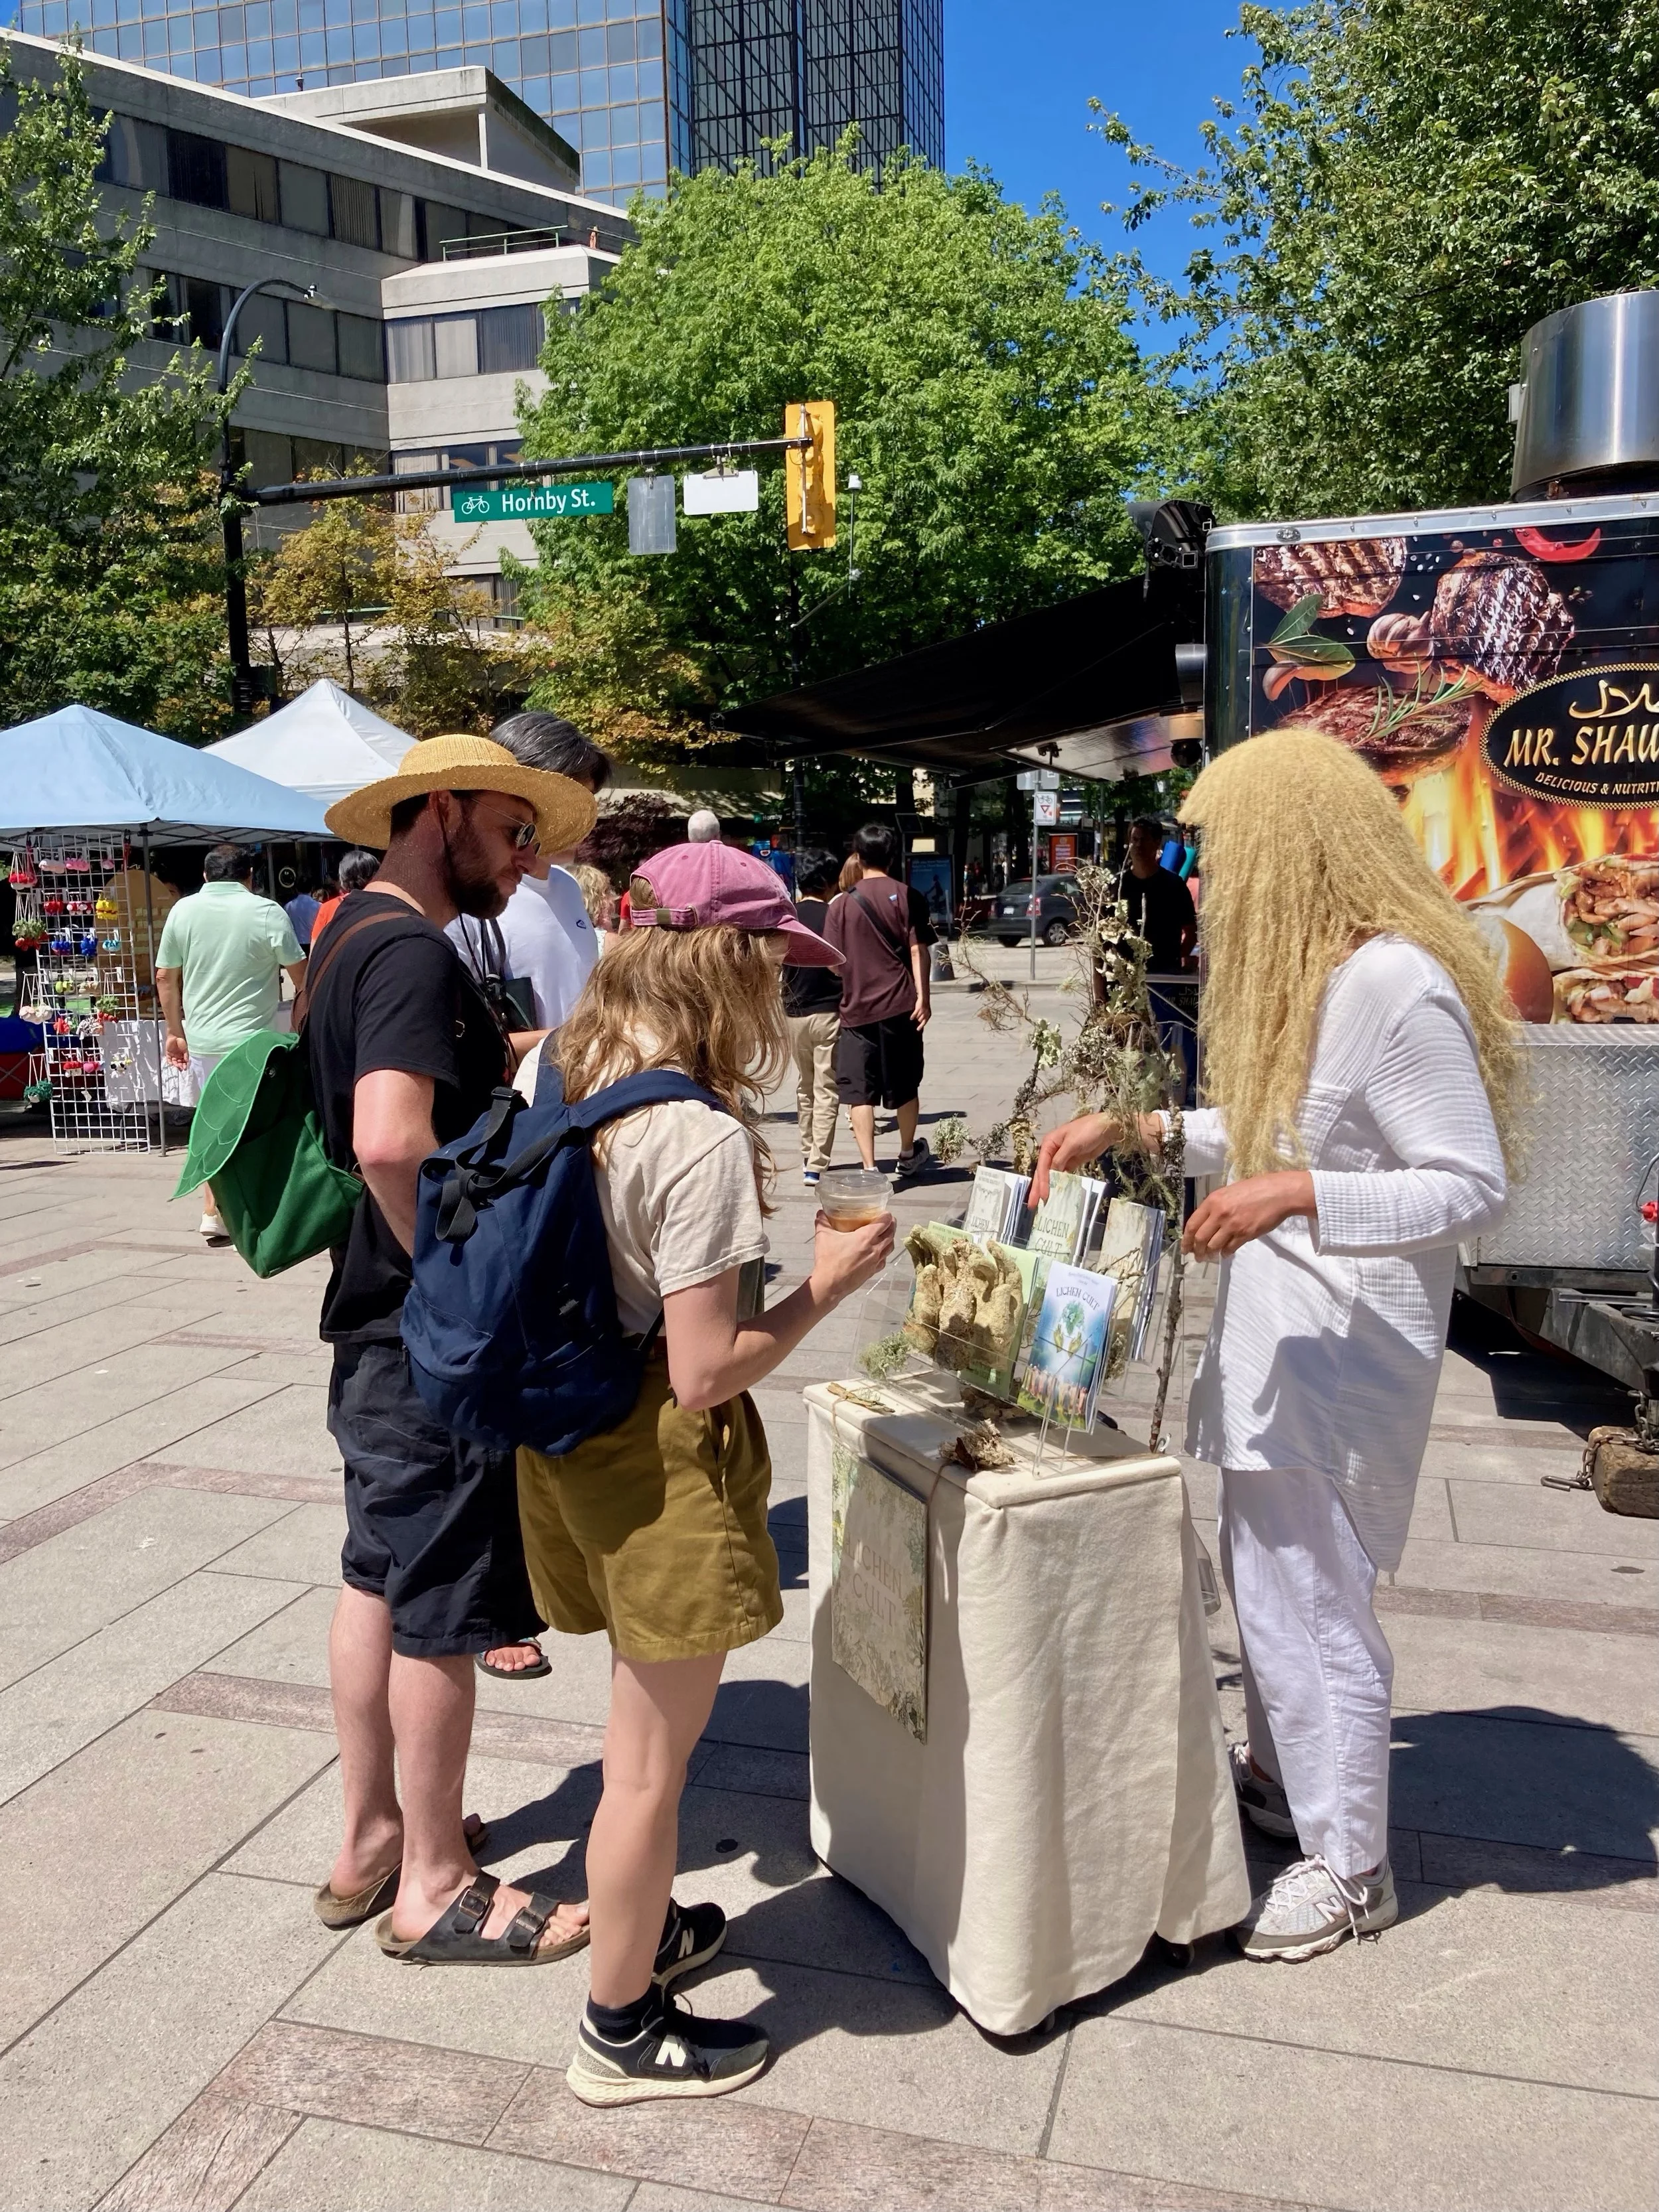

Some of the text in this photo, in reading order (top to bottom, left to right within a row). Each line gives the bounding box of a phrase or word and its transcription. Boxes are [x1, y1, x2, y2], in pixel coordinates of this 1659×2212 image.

[502, 488, 596, 514] Hornby St.
[1503, 728, 1559, 767] MR.
[1535, 772, 1599, 794] DELICIOUS
[1601, 784, 1609, 794] &
[1037, 1216, 1069, 1238] LICHEN
[1035, 1237, 1062, 1258] CULT
[1056, 1286, 1100, 1310] LICHEN CULT
[846, 1532, 902, 1600] LICHEN
[853, 1573, 896, 1627] CULT
[678, 1927, 695, 1959] N
[655, 2034, 688, 2067] N
